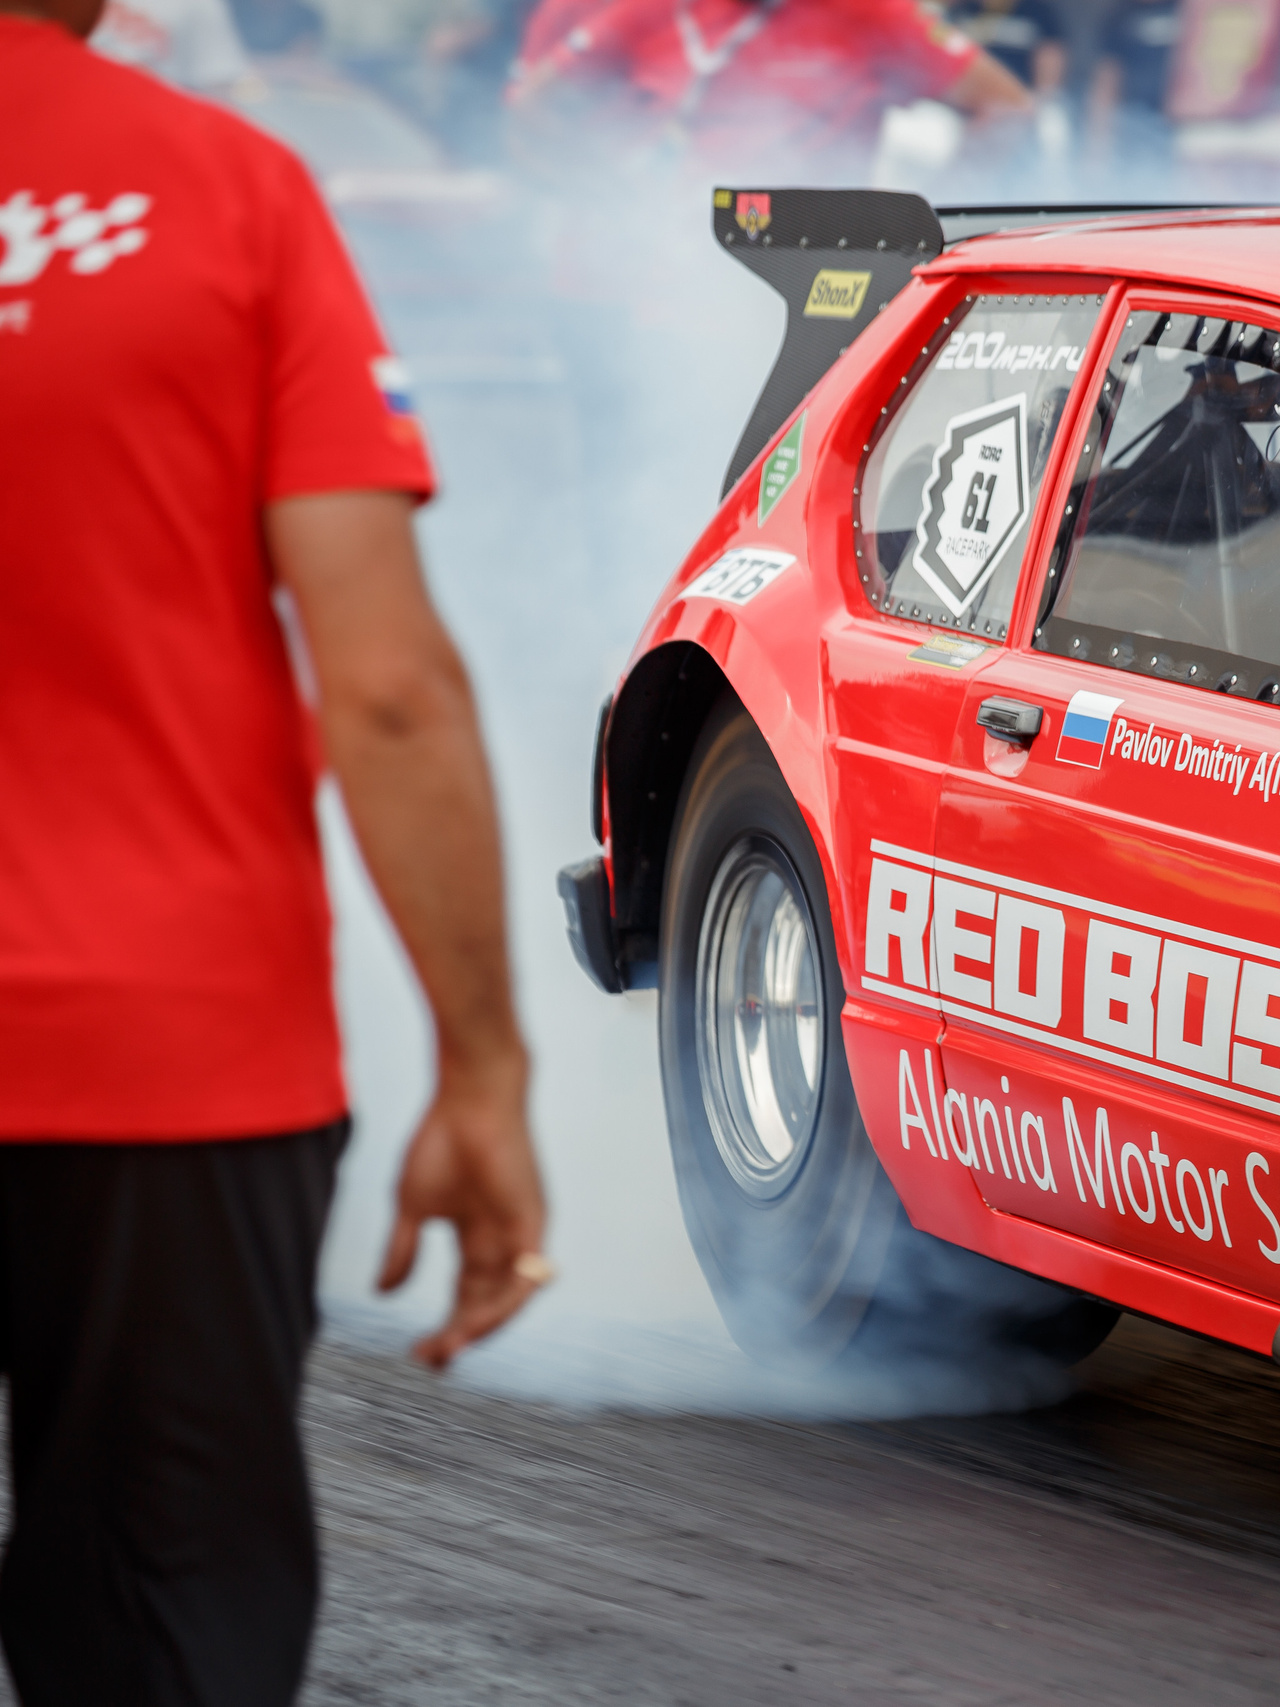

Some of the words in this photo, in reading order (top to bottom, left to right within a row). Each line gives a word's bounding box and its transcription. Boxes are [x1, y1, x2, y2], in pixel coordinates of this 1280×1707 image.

[961, 470, 998, 534] 61
[945, 536, 992, 561] RACEPARK
[1110, 718, 1174, 768] Pavlov
[1174, 733, 1250, 796] Dmitriy
[865, 857, 1067, 1029] RED
[900, 1048, 1058, 1194] Alania
[1062, 1096, 1233, 1248] Motor
